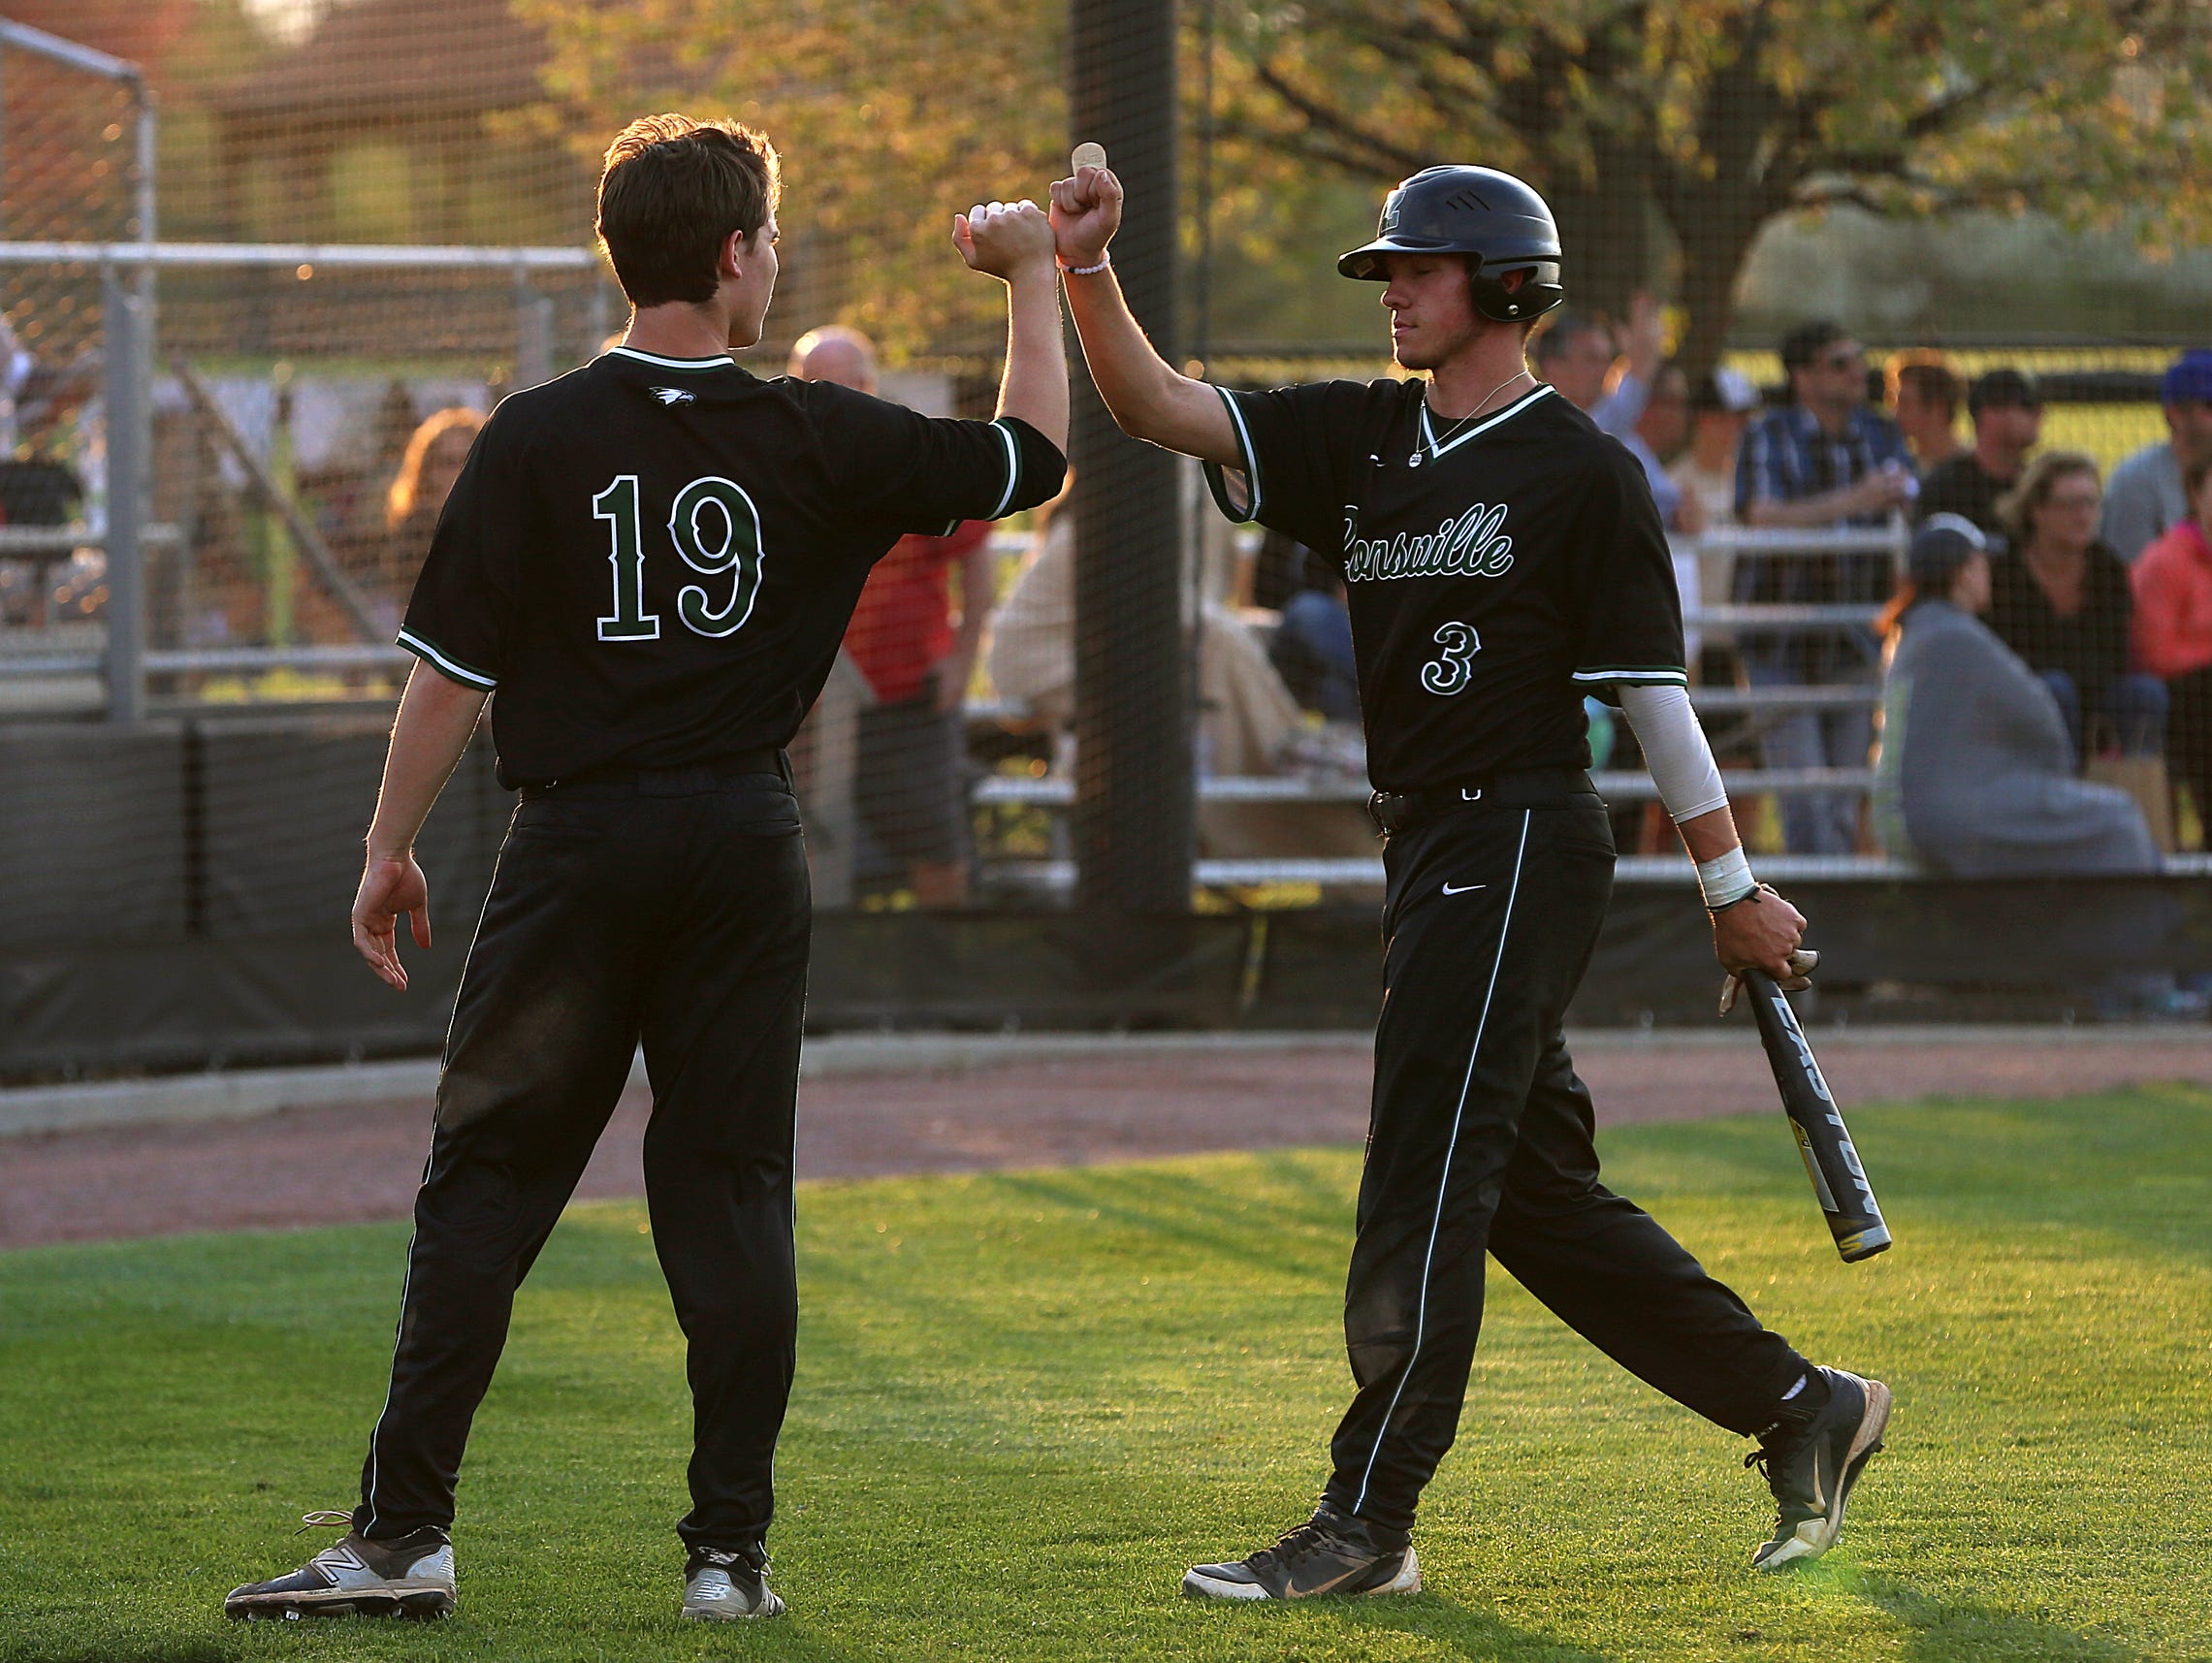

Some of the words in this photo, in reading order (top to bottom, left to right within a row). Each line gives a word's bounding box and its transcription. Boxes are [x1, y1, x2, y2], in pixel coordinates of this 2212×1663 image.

[593, 474, 766, 642] 19
[1344, 502, 1515, 582] onsville
[1421, 621, 1483, 696] 3
